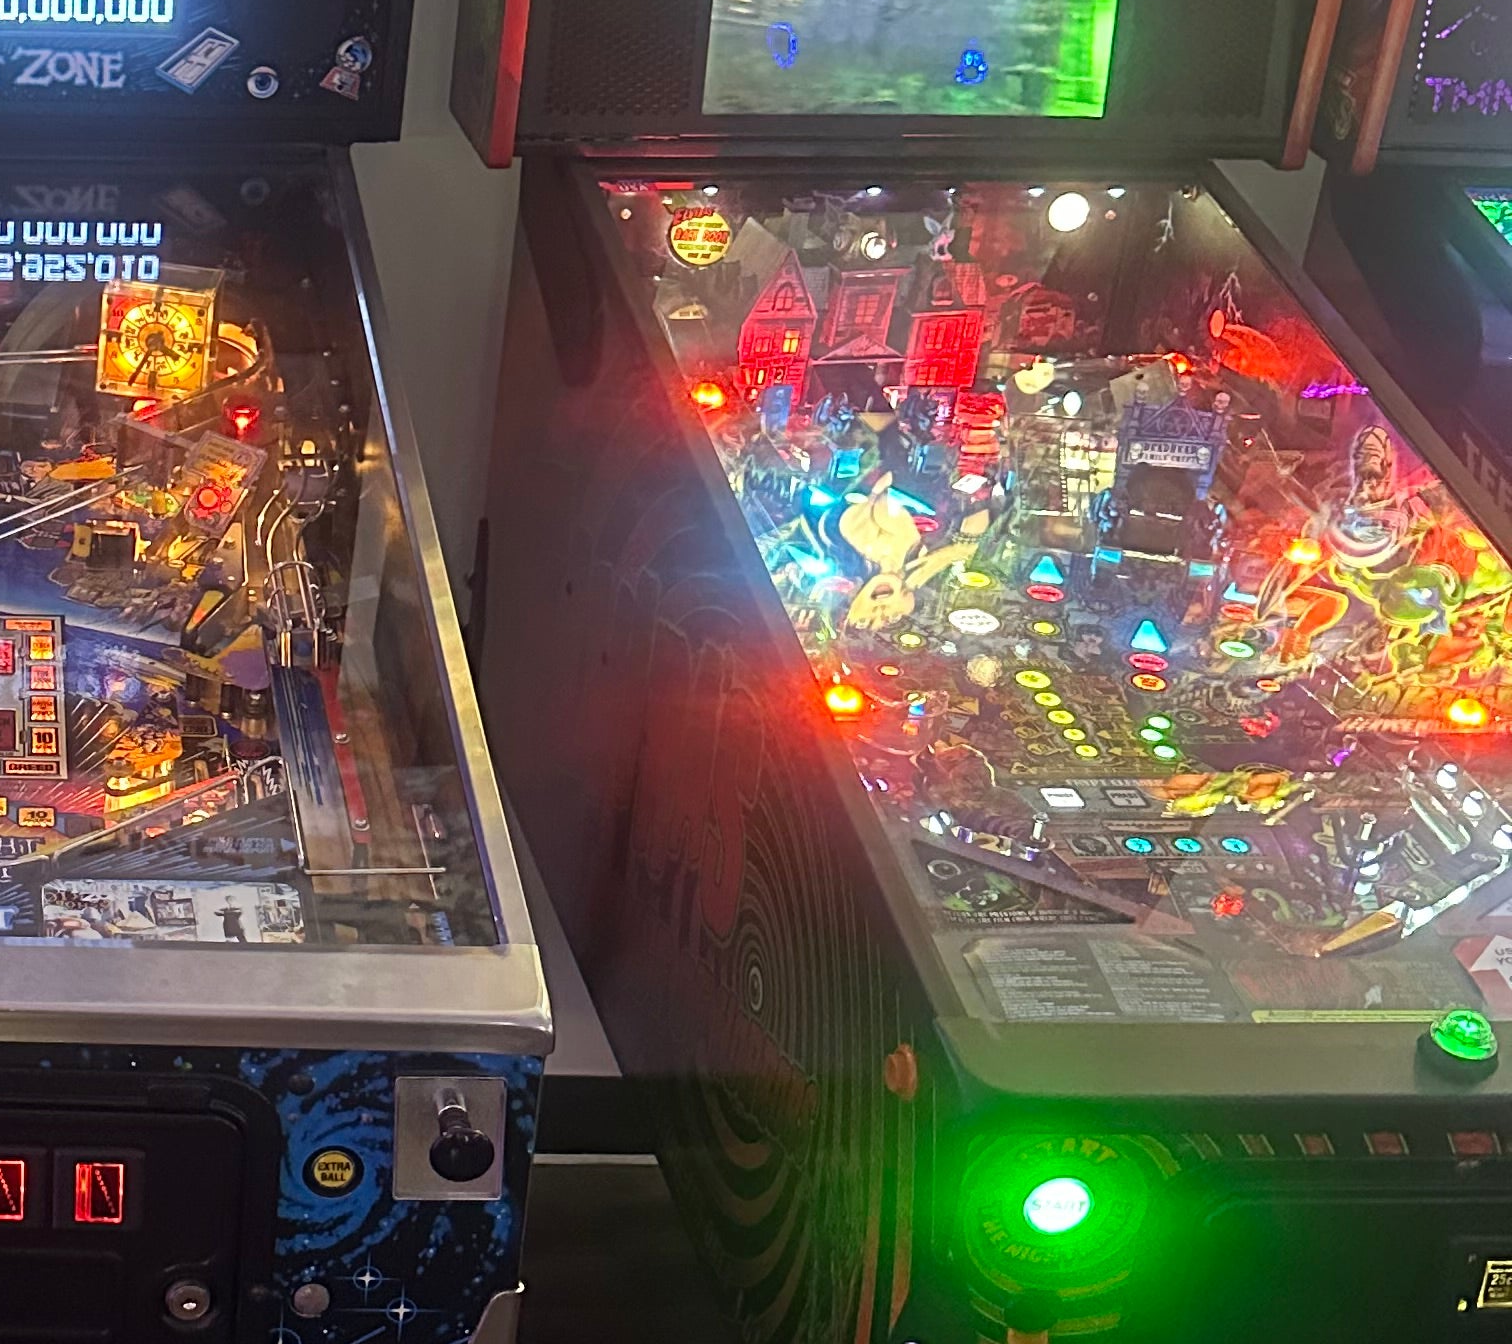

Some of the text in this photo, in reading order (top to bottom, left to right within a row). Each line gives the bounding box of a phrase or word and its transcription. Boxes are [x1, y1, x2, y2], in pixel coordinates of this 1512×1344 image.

[12, 46, 127, 90] ZONE
[34, 731, 54, 744] 10
[8, 763, 54, 772] GREED
[27, 810, 48, 819] 10
[317, 1161, 352, 1174] EXTRA
[320, 1171, 347, 1184] BALL
